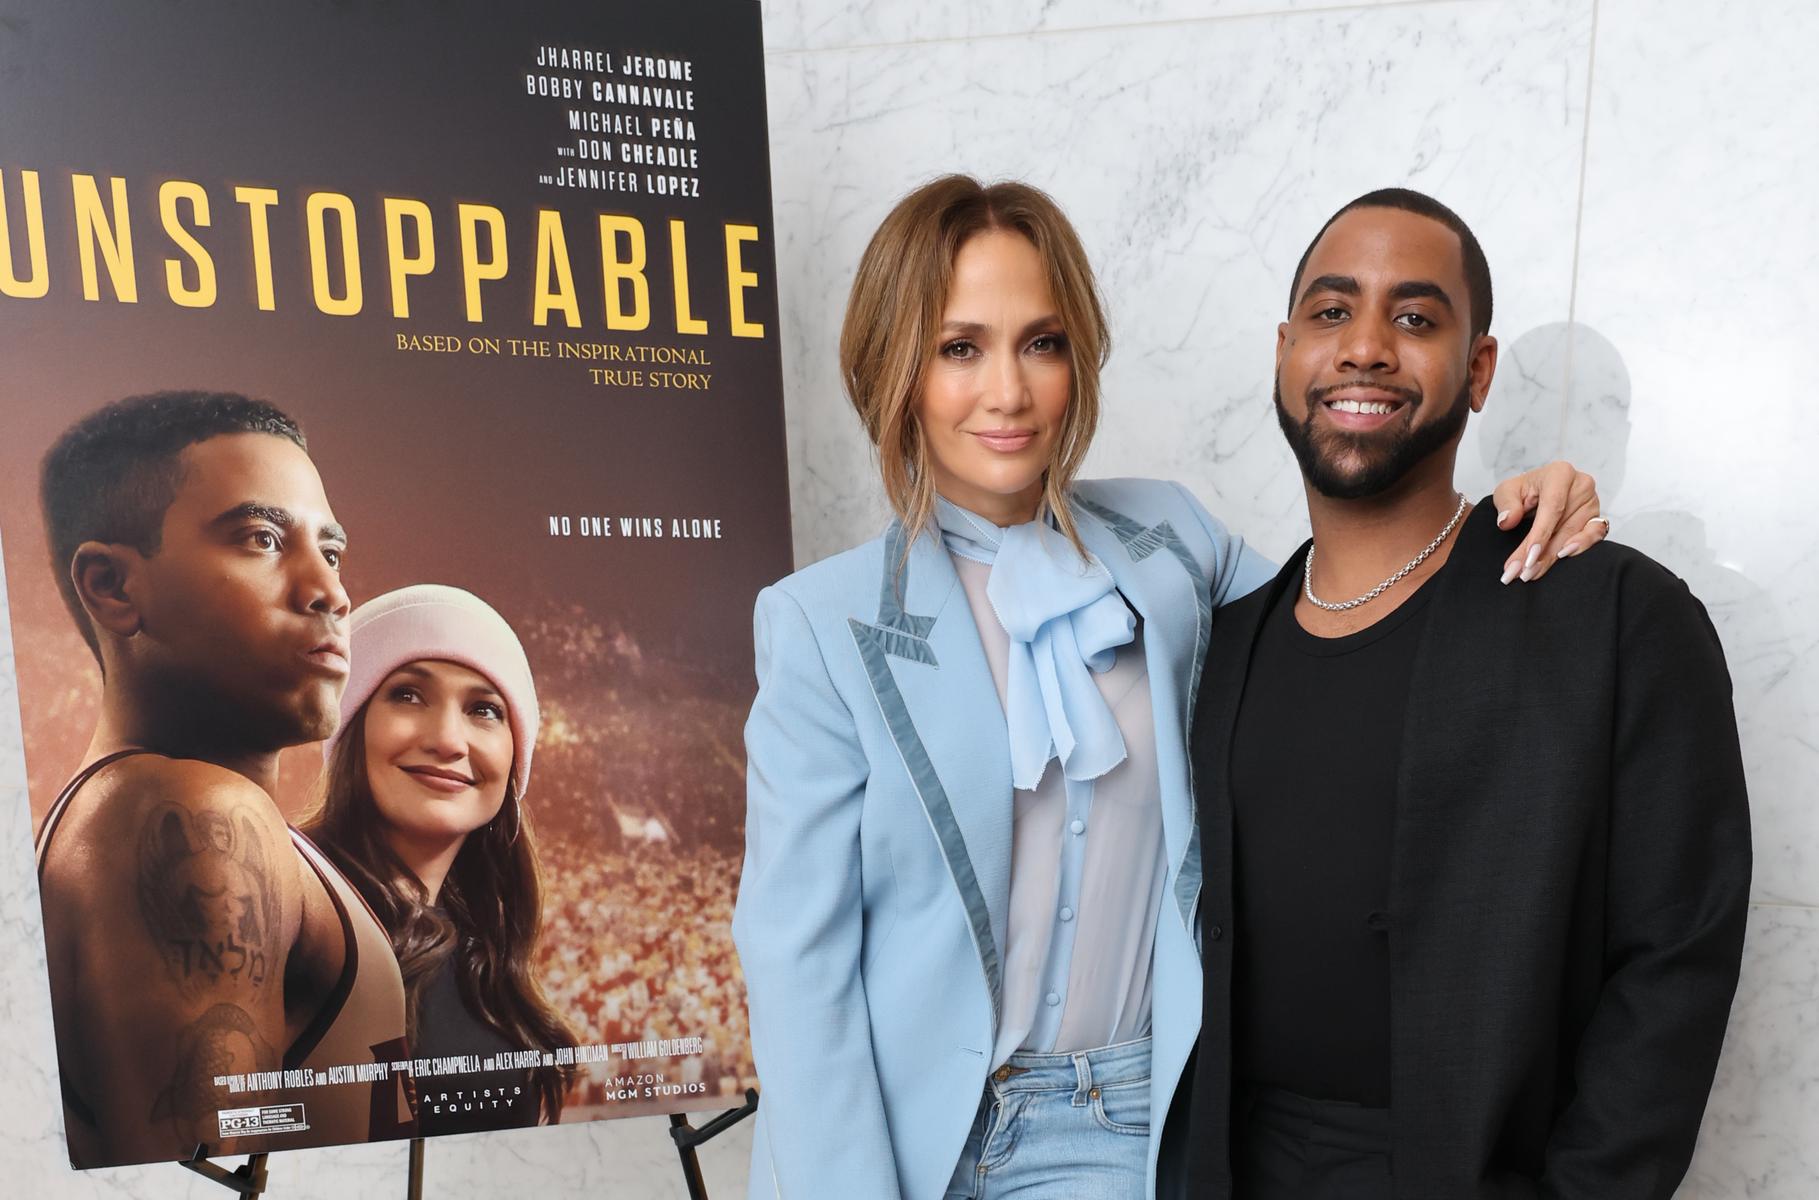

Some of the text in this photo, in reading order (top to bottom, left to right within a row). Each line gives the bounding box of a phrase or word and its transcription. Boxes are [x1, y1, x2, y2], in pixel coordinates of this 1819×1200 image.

[537, 46, 692, 81] JHARREL JEROME
[526, 74, 694, 110] BOBBY CANNAVALE
[569, 110, 696, 141] MICHAEL PEÑA
[557, 139, 698, 168] WITH DON CHEADLE
[539, 166, 699, 197] AND JENNIFER LOPEZ
[0, 169, 764, 338] UNSTOPPABLE
[397, 334, 712, 366] BASED ON THE INSPIRATIONAL
[589, 369, 712, 390] TRUE STORY
[549, 516, 722, 539] NO ONE WINS ALONE
[247, 1070, 283, 1092] ANTHONY
[284, 1069, 314, 1088] ROBLES
[315, 1072, 327, 1085] AND
[328, 1066, 355, 1084] AUSTIN
[356, 1063, 388, 1081] MURPHY
[414, 1059, 432, 1078] ERIC
[432, 1055, 481, 1076] CHAMPNELLA
[483, 1058, 495, 1071] AND
[495, 1053, 513, 1070] ALEX
[514, 1049, 541, 1068] HARRIS
[554, 1047, 574, 1066] JOHN
[574, 1044, 609, 1063] HINDMAN
[627, 1039, 658, 1060] WILLIAM
[659, 1037, 703, 1056] GOLDENBERG
[424, 1086, 521, 1103] ARTISTS
[605, 1073, 664, 1087] AMAZON
[606, 1082, 706, 1101] MGM STUDIOS
[434, 1099, 513, 1114] EQUITY
[221, 1117, 259, 1129] PG-13
